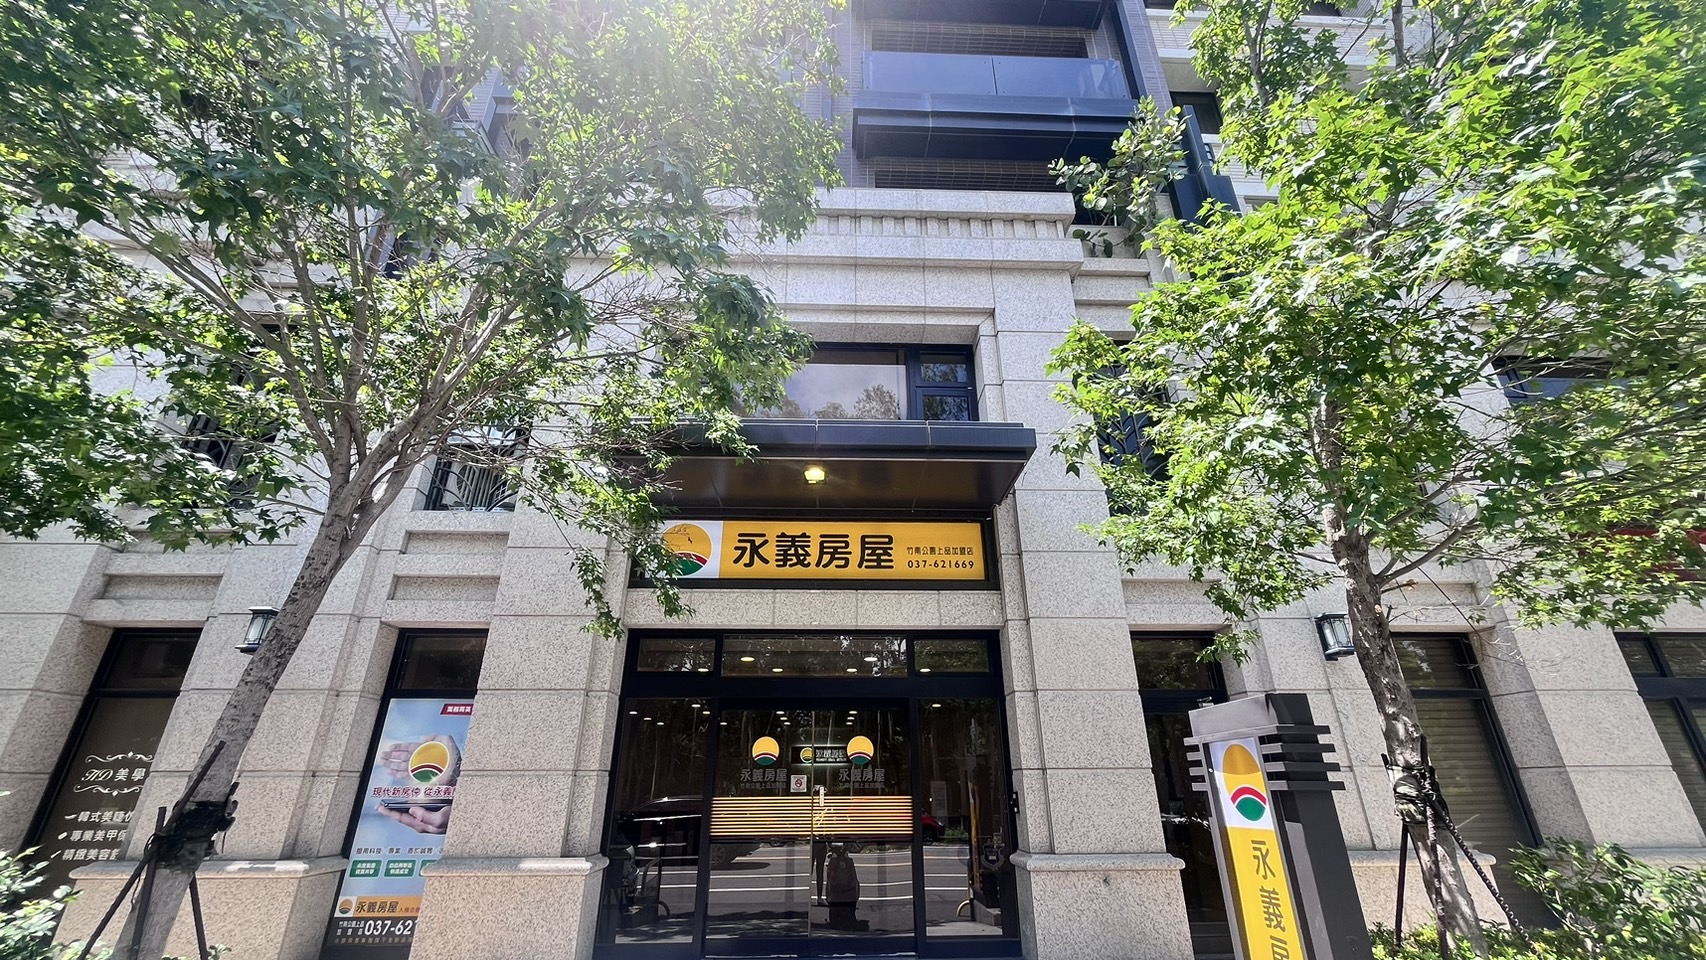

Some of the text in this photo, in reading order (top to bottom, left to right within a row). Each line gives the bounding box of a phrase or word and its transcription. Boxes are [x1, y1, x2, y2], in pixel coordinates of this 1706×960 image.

[732, 532, 894, 569] 永義房屋
[906, 546, 974, 556] 竹南公園上品加盟店
[907, 559, 975, 569] 037-621669
[740, 768, 788, 782] 永義房屋
[838, 768, 886, 782] 永義房屋
[372, 785, 457, 798] 現代新房仲 從永義
[355, 901, 399, 913] 永義房屋
[364, 920, 418, 936] 037-62
